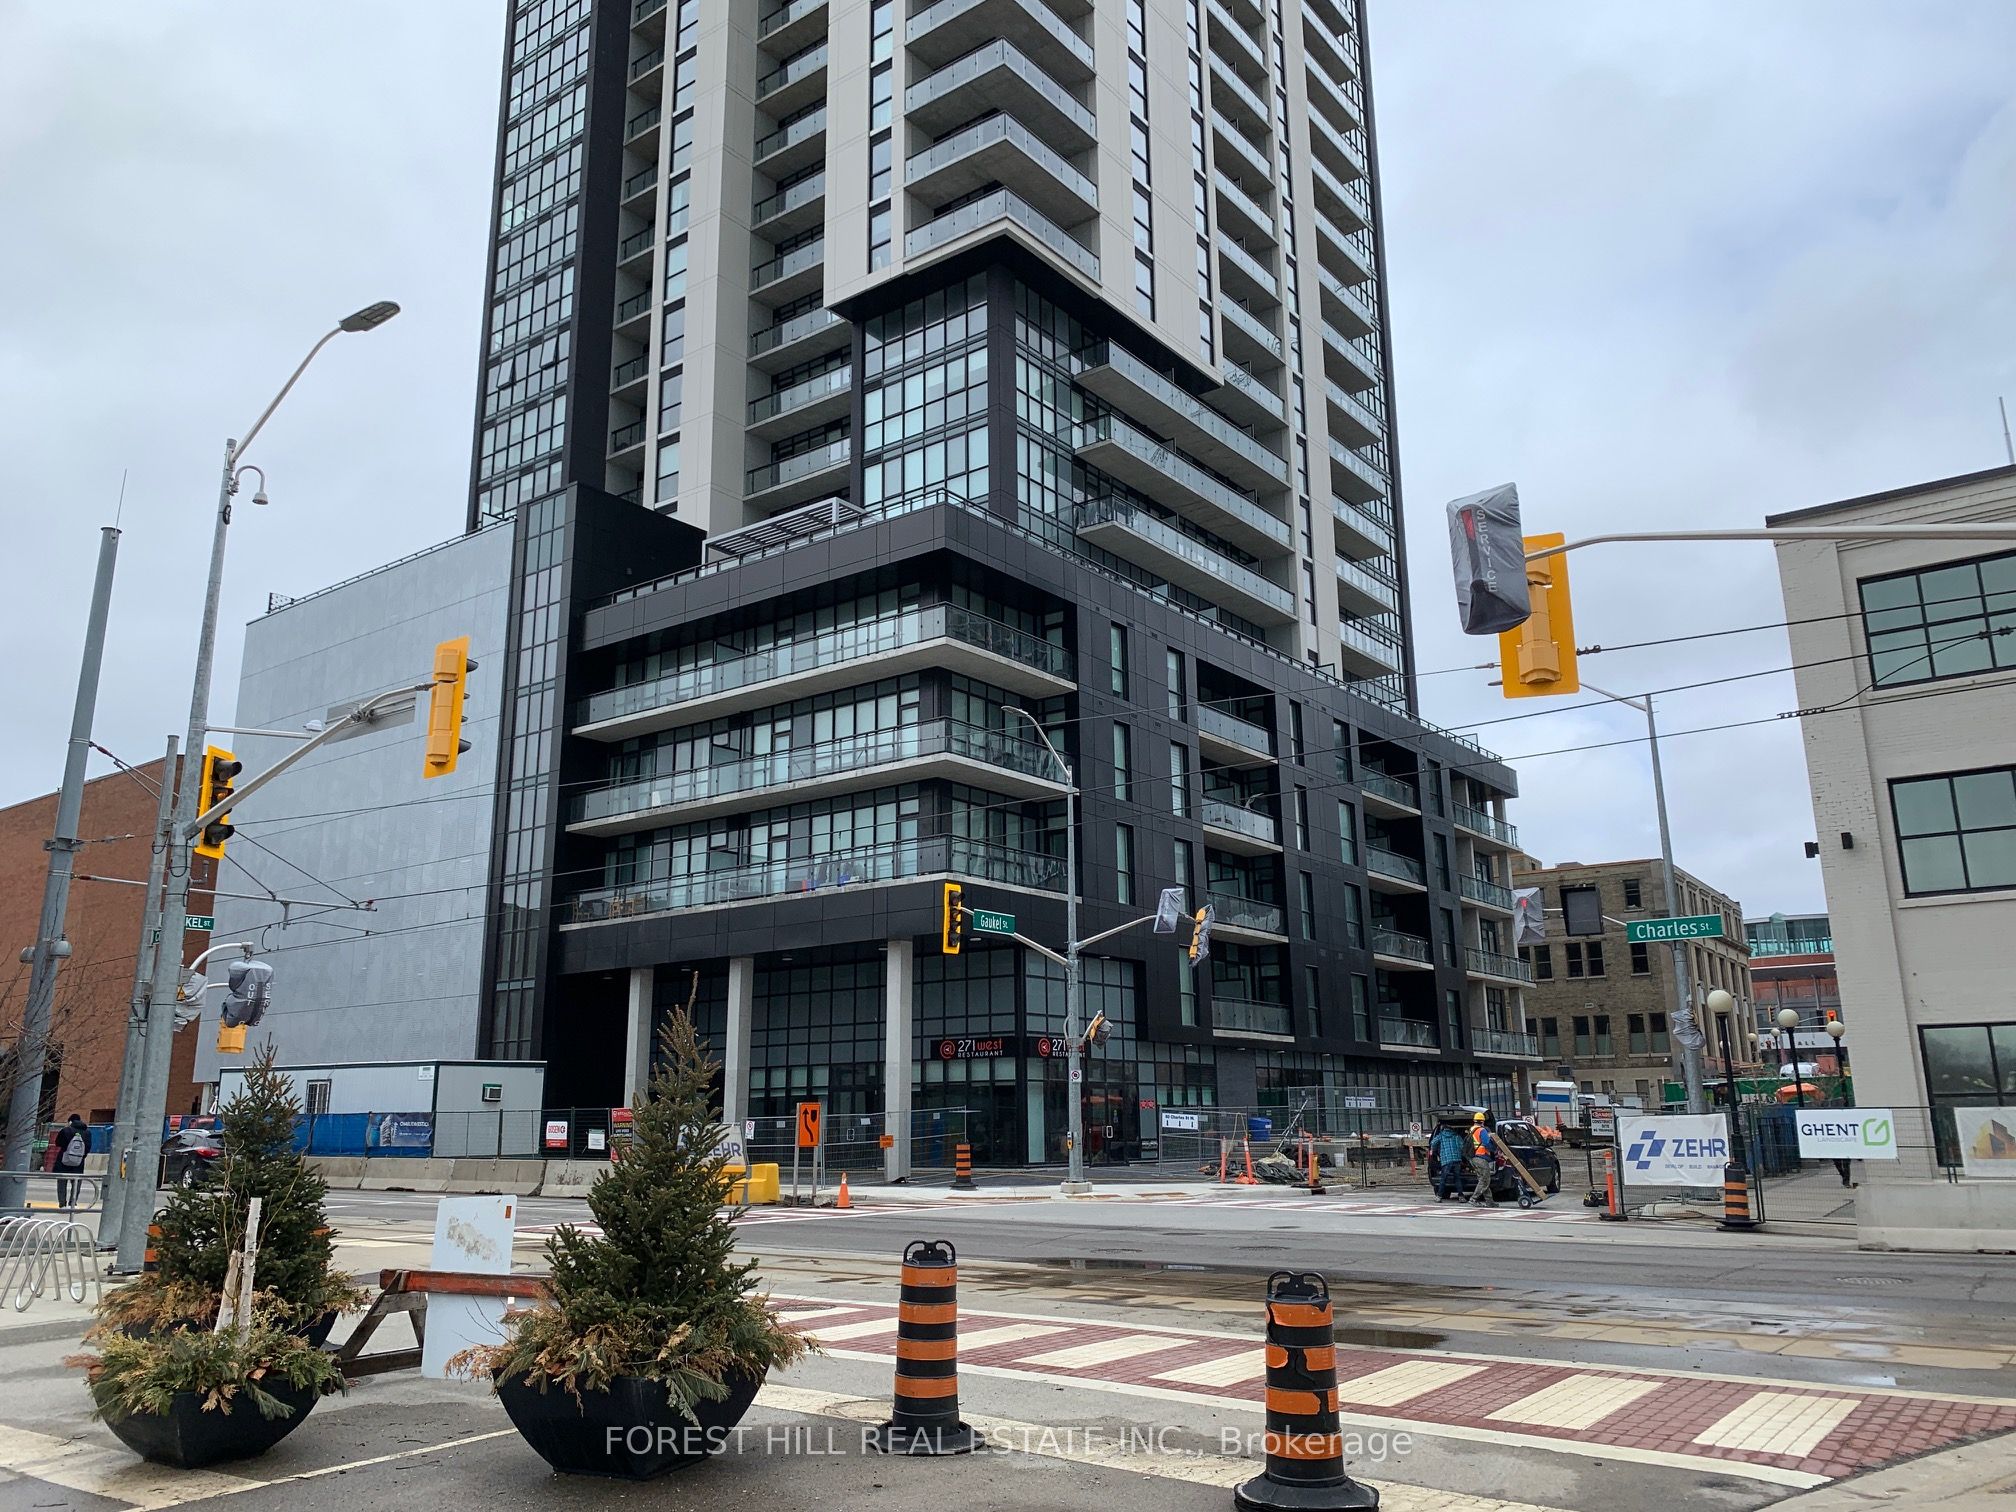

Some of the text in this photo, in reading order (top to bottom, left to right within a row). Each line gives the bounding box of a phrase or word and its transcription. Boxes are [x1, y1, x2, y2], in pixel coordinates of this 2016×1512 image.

[1476, 509, 1497, 592] SERVICE
[186, 917, 203, 928] KEL
[980, 914, 1002, 930] Gaukel
[1636, 921, 1712, 939] Charles St.
[957, 1050, 1003, 1058] RESTAURANT
[1801, 1123, 1859, 1136] GHENT
[707, 1142, 742, 1157] EHR
[1672, 1138, 1727, 1158] ZEHR
